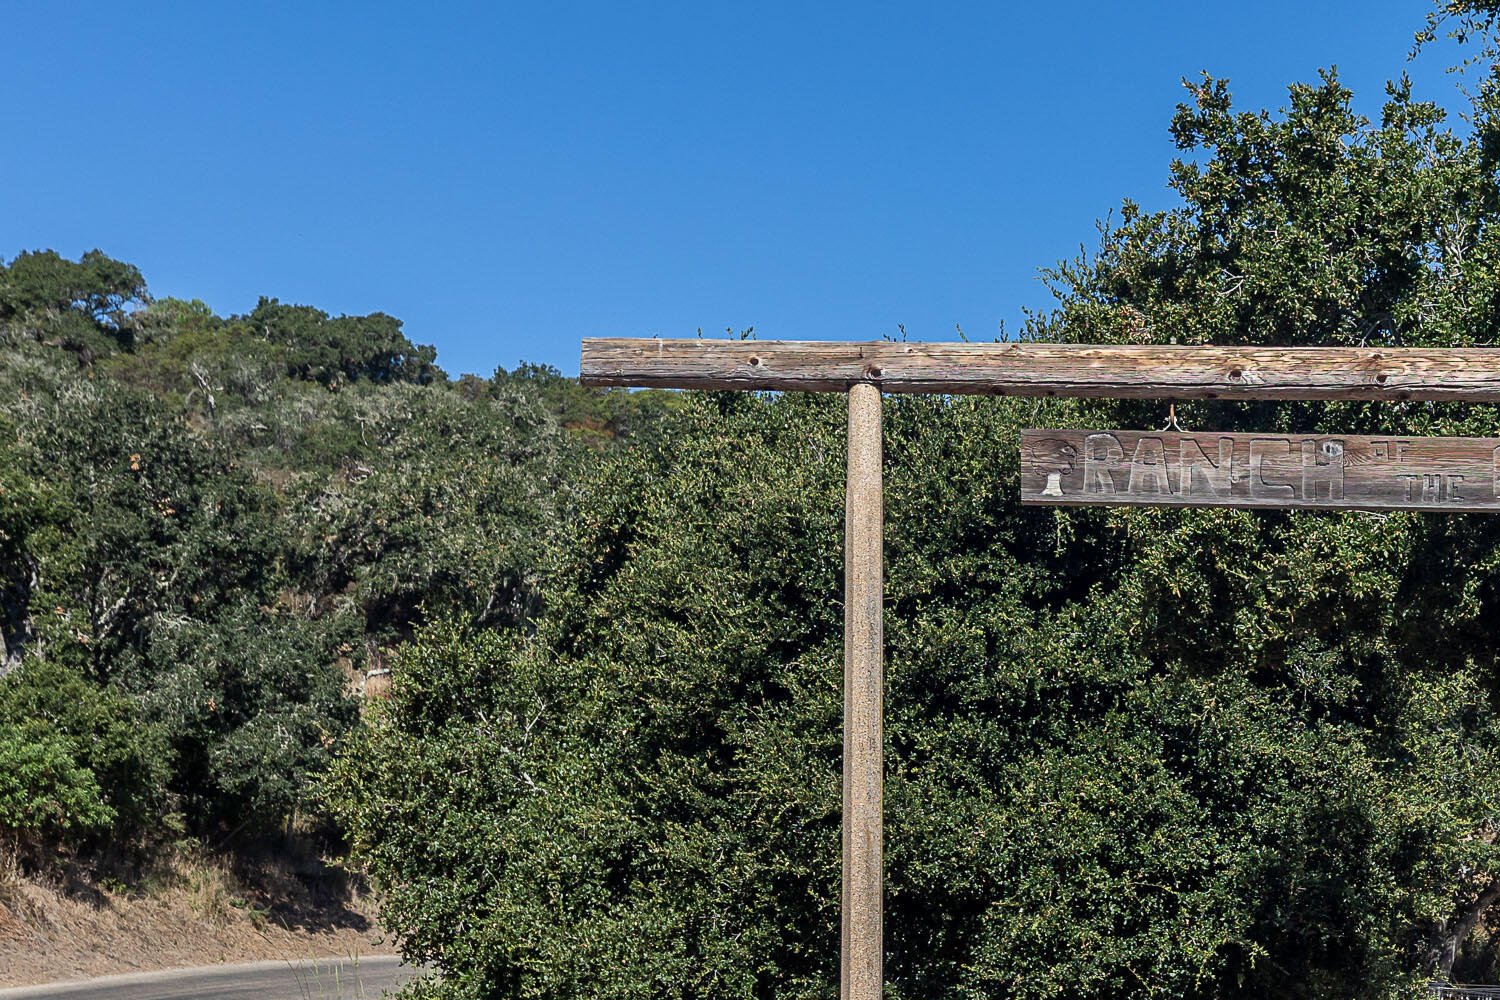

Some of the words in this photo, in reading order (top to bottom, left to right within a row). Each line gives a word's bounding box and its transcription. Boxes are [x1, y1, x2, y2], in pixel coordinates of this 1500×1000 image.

[1083, 433, 1345, 500] RANCH
[1370, 440, 1411, 463] OF
[1396, 475, 1464, 504] THE
